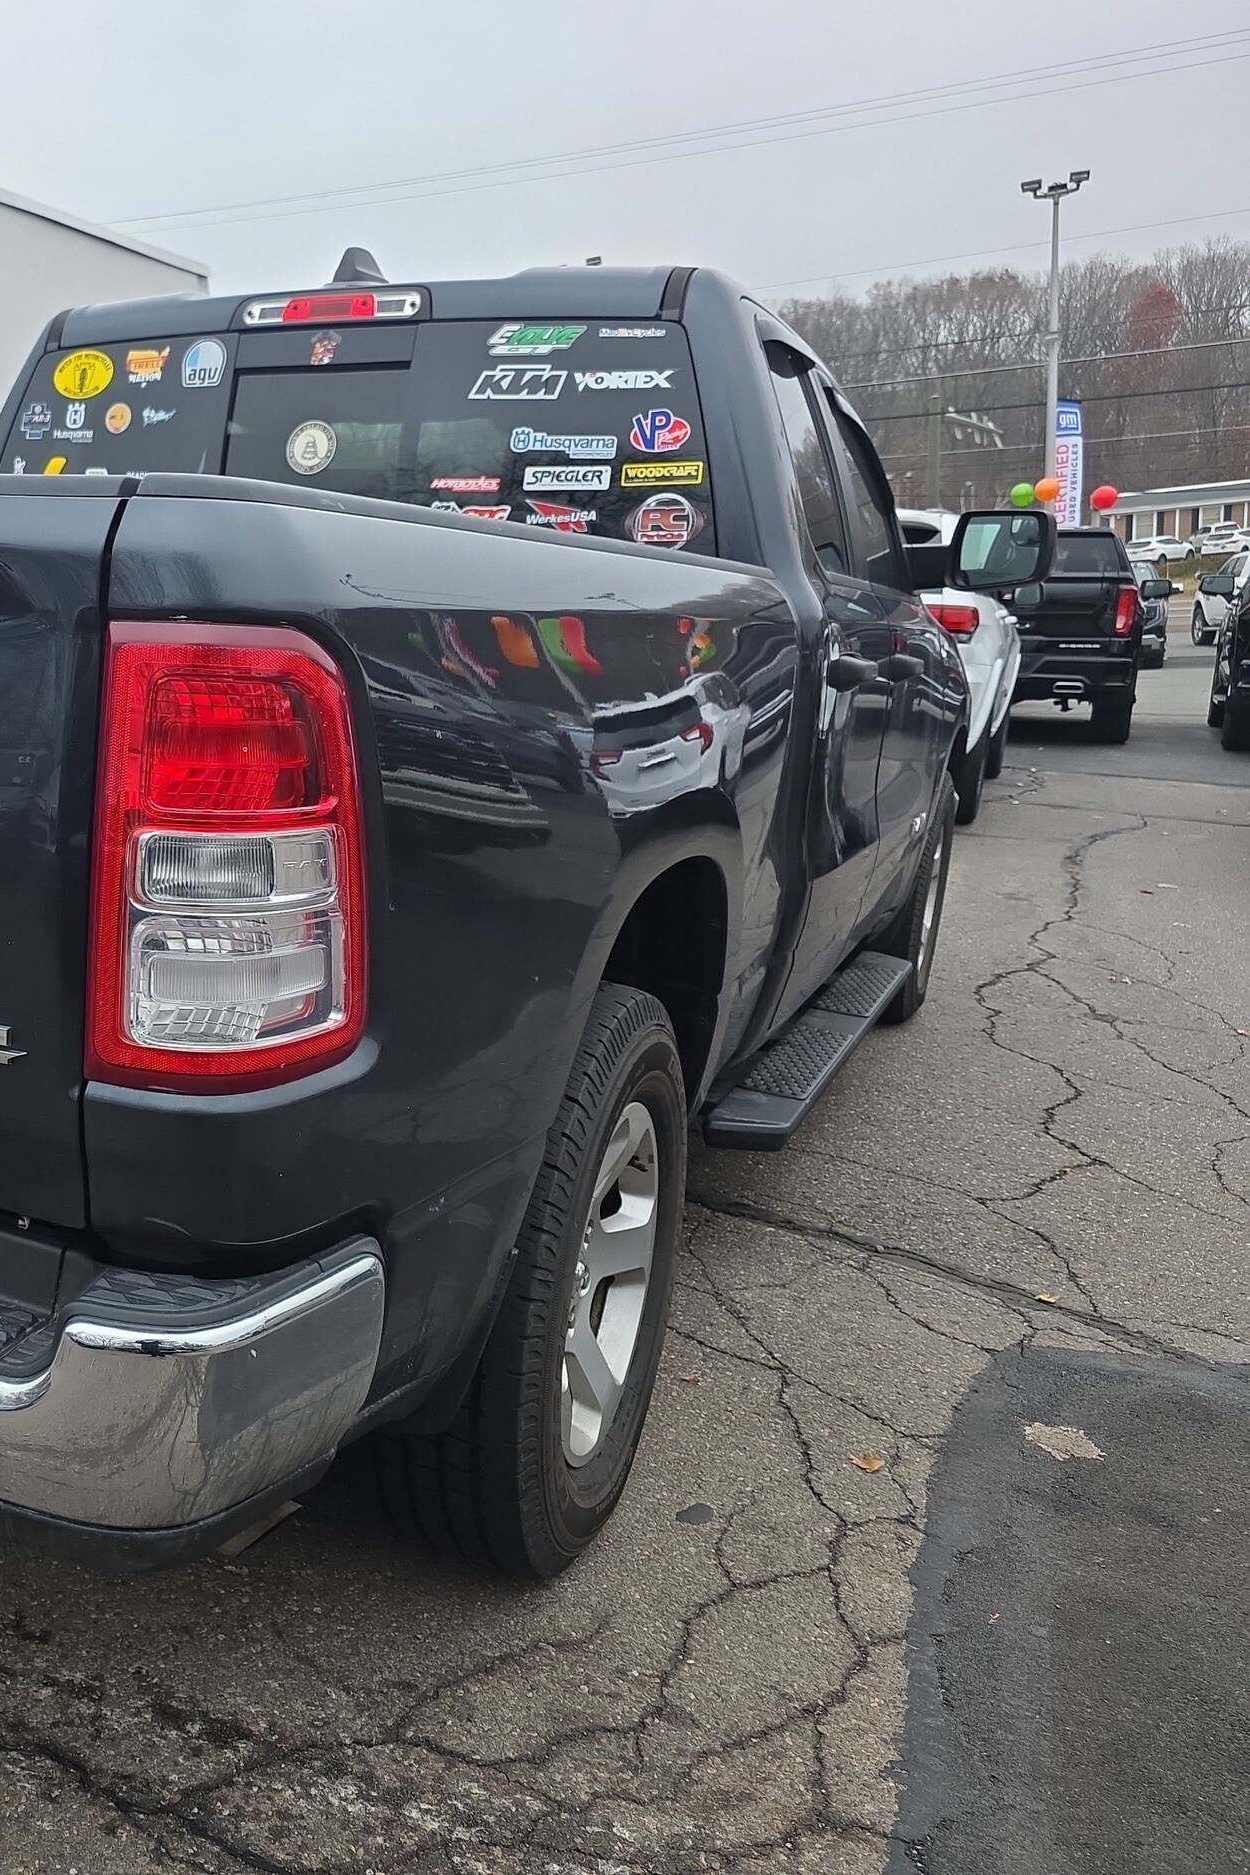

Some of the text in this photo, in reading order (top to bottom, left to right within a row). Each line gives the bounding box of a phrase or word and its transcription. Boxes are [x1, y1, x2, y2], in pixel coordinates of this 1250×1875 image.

[188, 367, 219, 384] agv
[469, 365, 567, 399] KTM
[574, 370, 674, 391] VORTEX
[1059, 413, 1078, 429] gm
[53, 429, 94, 440] Husqvarna
[634, 410, 671, 451] VP
[532, 434, 615, 450] Husqvarna
[526, 470, 603, 485] SPIEGLER
[627, 465, 698, 478] WOODCRAFT
[1054, 444, 1070, 525] CERTIFIED
[1068, 443, 1079, 523] USED VEHICLES
[526, 510, 597, 525] WerkesUSA
